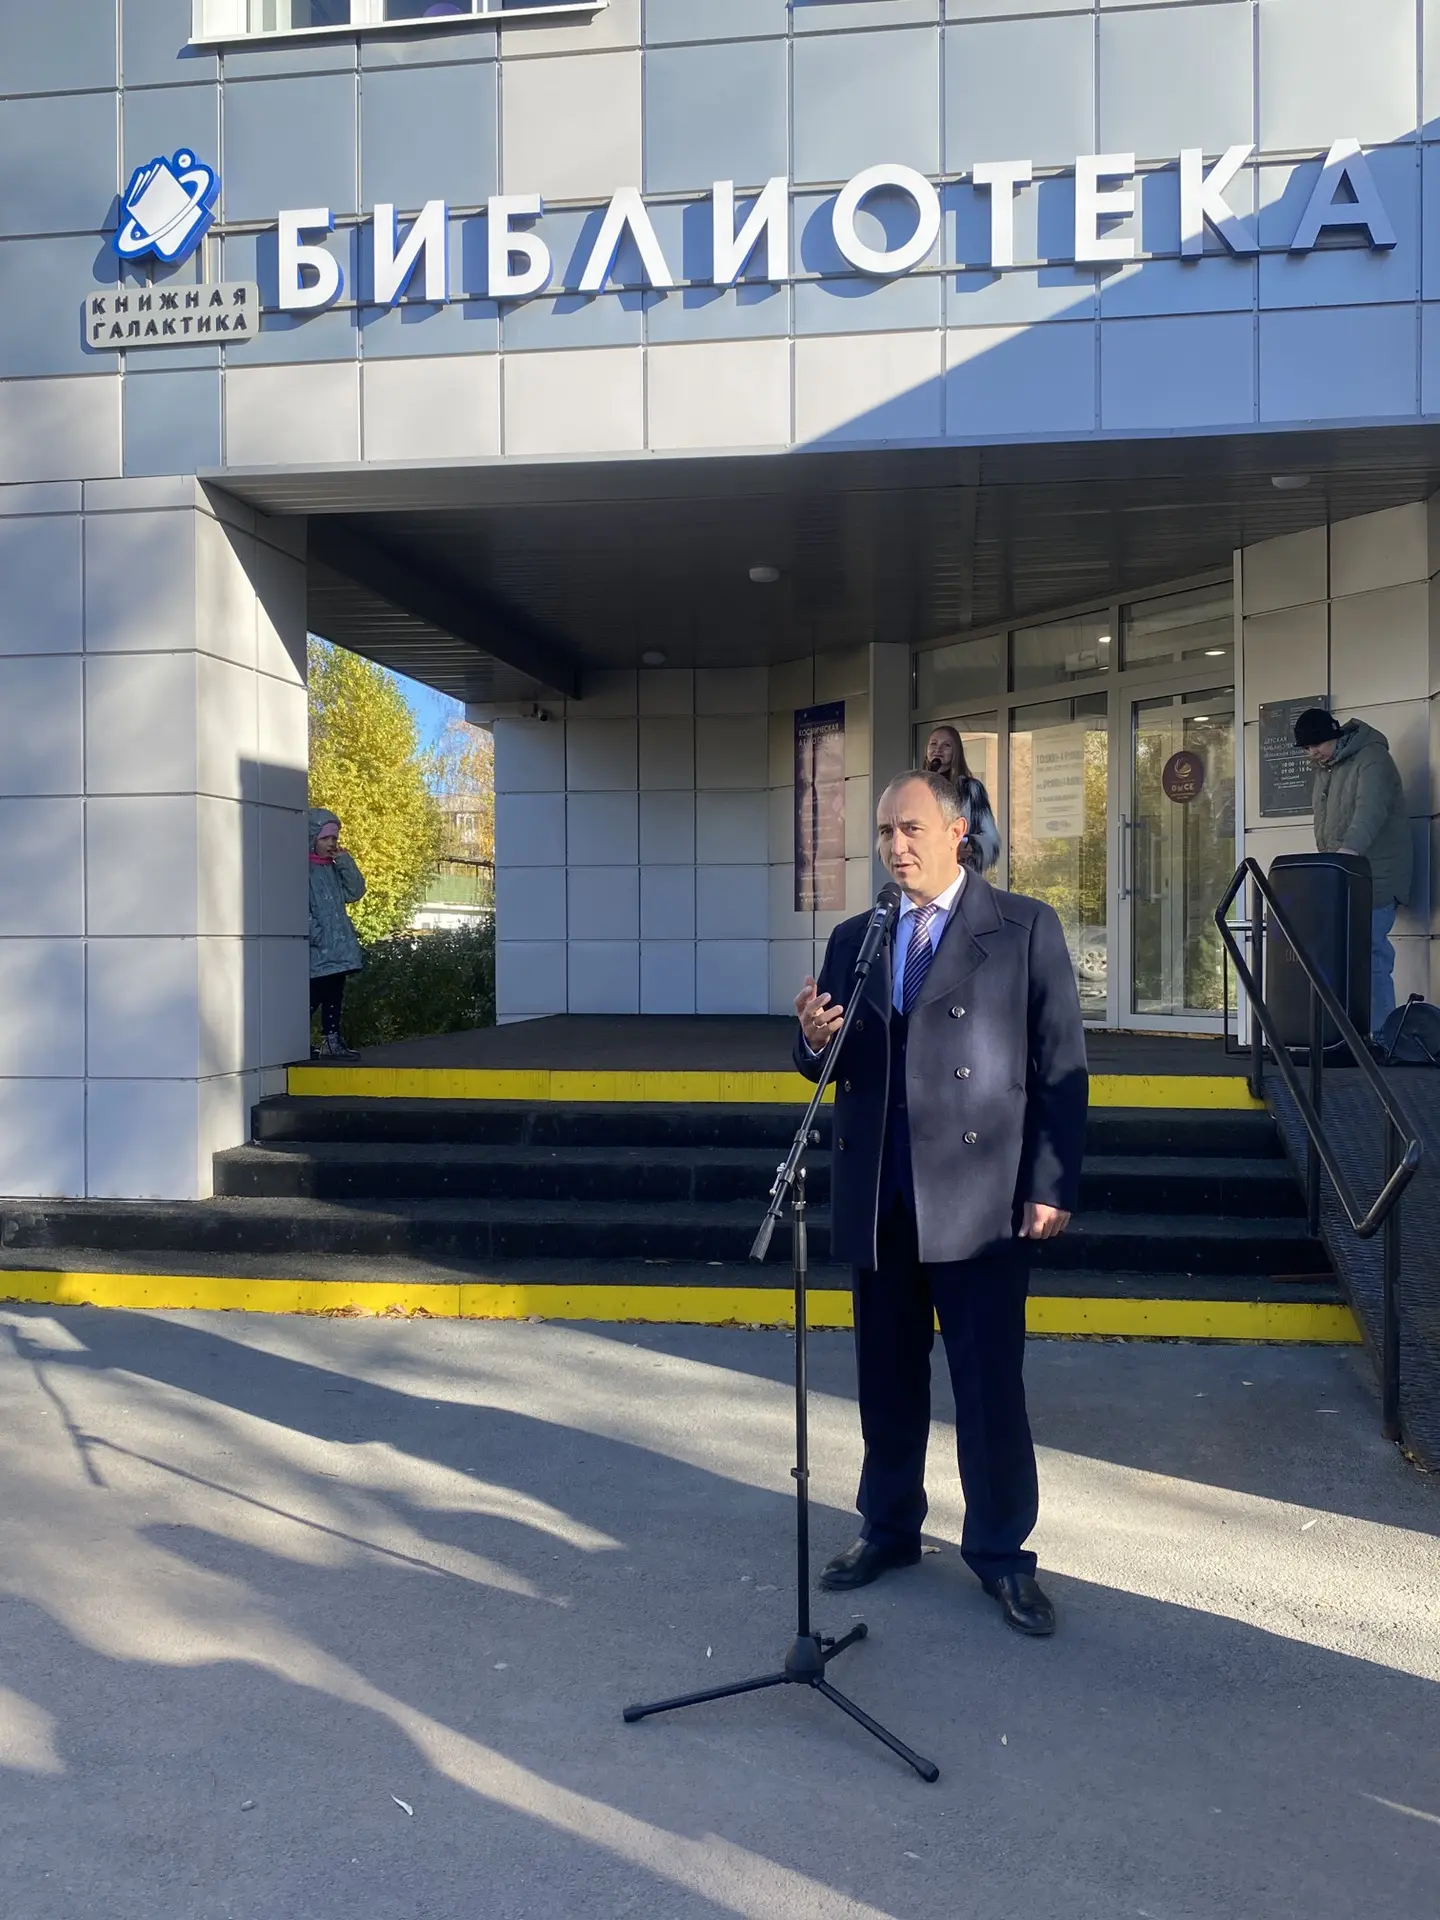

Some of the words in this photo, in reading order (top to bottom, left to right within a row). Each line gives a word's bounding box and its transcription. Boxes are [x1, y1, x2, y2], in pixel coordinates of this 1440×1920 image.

[278, 137, 1397, 312] БИБЛИОТЕКА
[92, 287, 246, 315] КНИЖНАЯ
[93, 313, 247, 340] ГАЛАКТИКА
